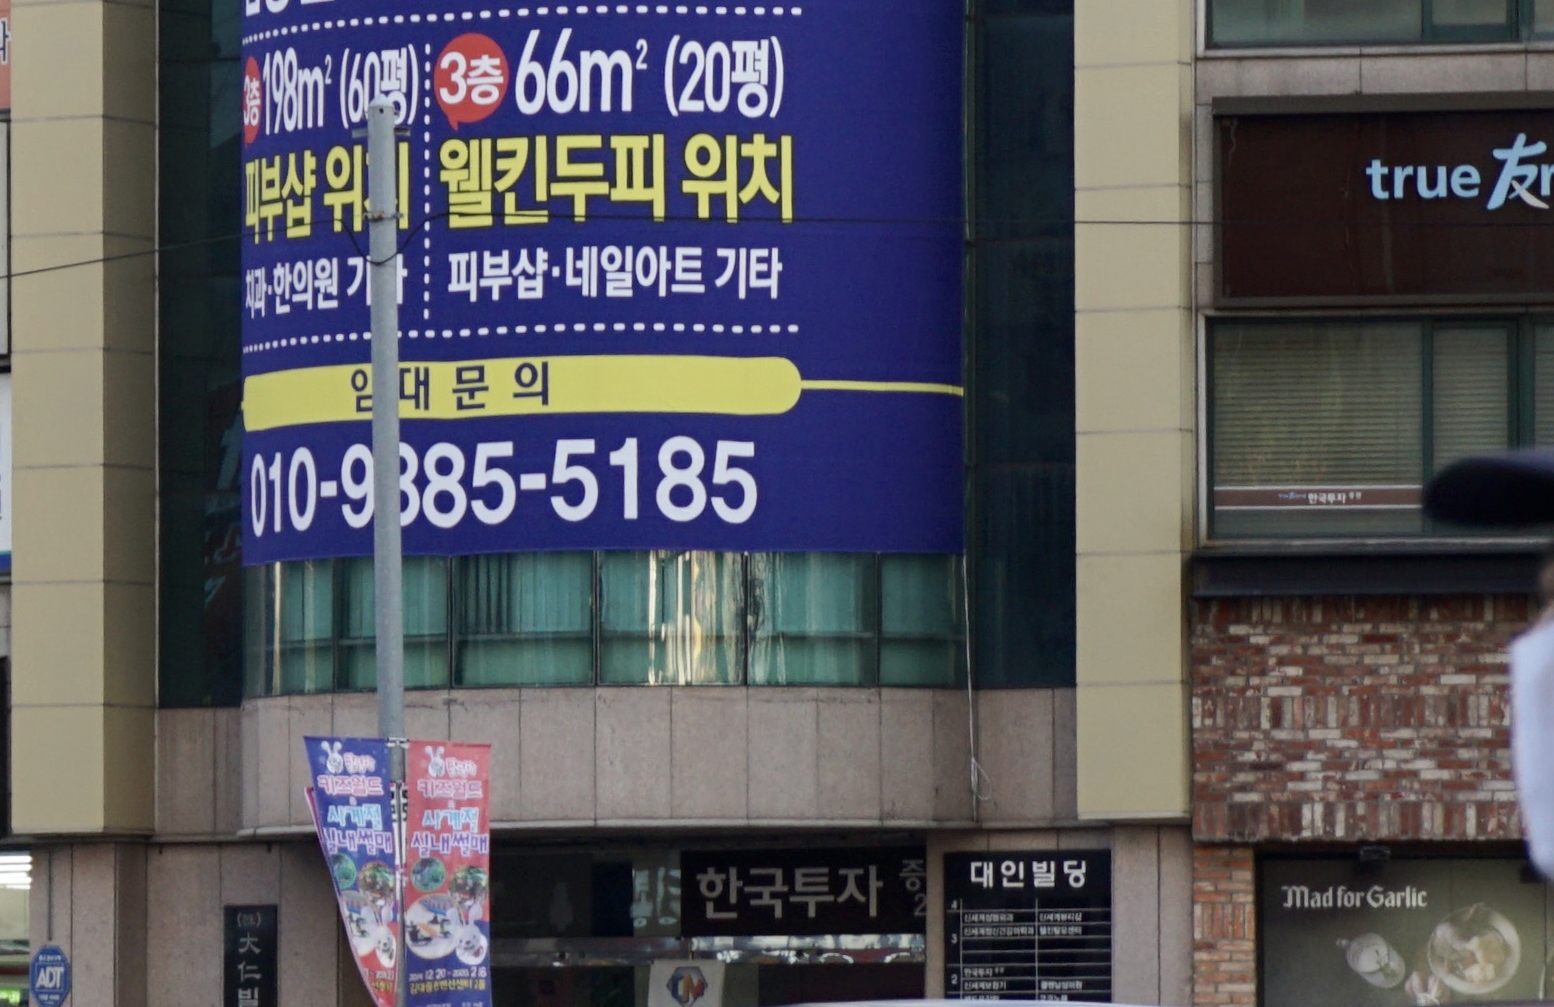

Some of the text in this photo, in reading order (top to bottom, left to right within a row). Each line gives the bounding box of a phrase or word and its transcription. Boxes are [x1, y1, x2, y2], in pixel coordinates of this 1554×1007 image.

[340, 43, 419, 130] (60평)
[439, 51, 504, 106] 3층
[664, 35, 784, 117] (20평)
[245, 149, 317, 245] 피부샵
[439, 133, 794, 229] 웰킨두피 위치
[1365, 158, 1482, 201] true
[714, 245, 784, 300] 기타
[696, 864, 884, 921] 한국투자
[970, 859, 1087, 889] 대인빌딩
[1281, 884, 1428, 910] Mad for Garlic
[35, 969, 64, 989] ADT
